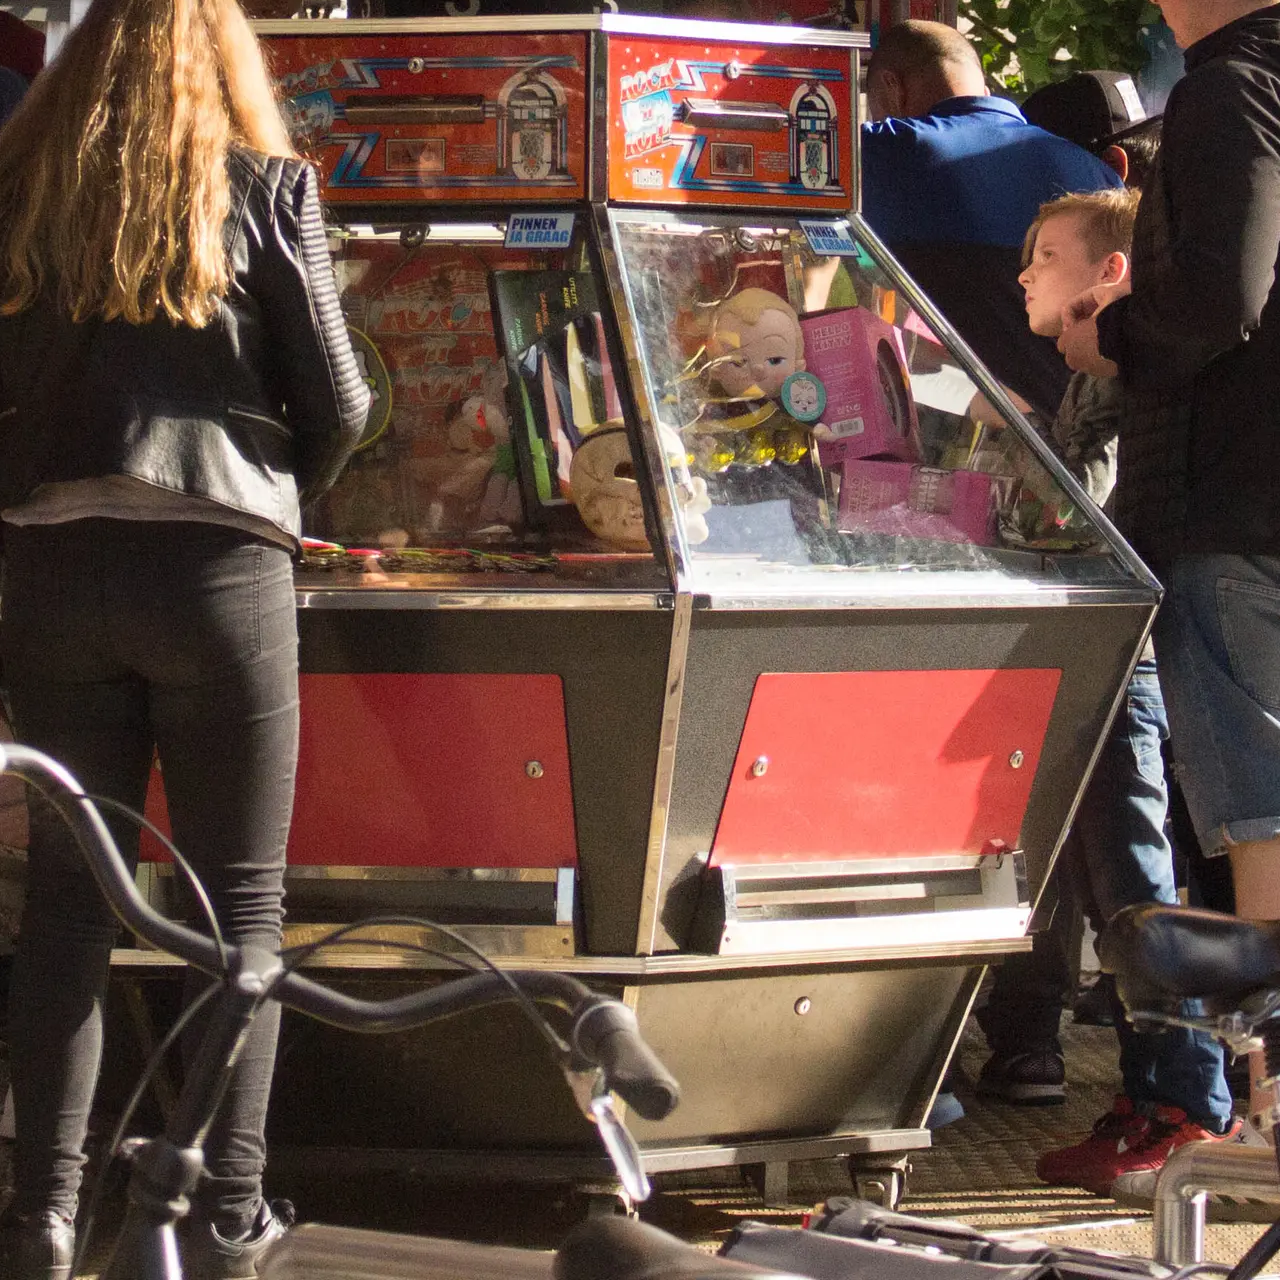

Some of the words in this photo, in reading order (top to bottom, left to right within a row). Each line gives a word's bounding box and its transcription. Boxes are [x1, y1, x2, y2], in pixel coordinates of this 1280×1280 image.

[512, 218, 558, 231] PINNEN
[526, 230, 569, 243] GRAAG
[805, 225, 839, 238] PINNEN
[568, 277, 578, 305] UTILITY
[812, 322, 850, 339] HELLO
